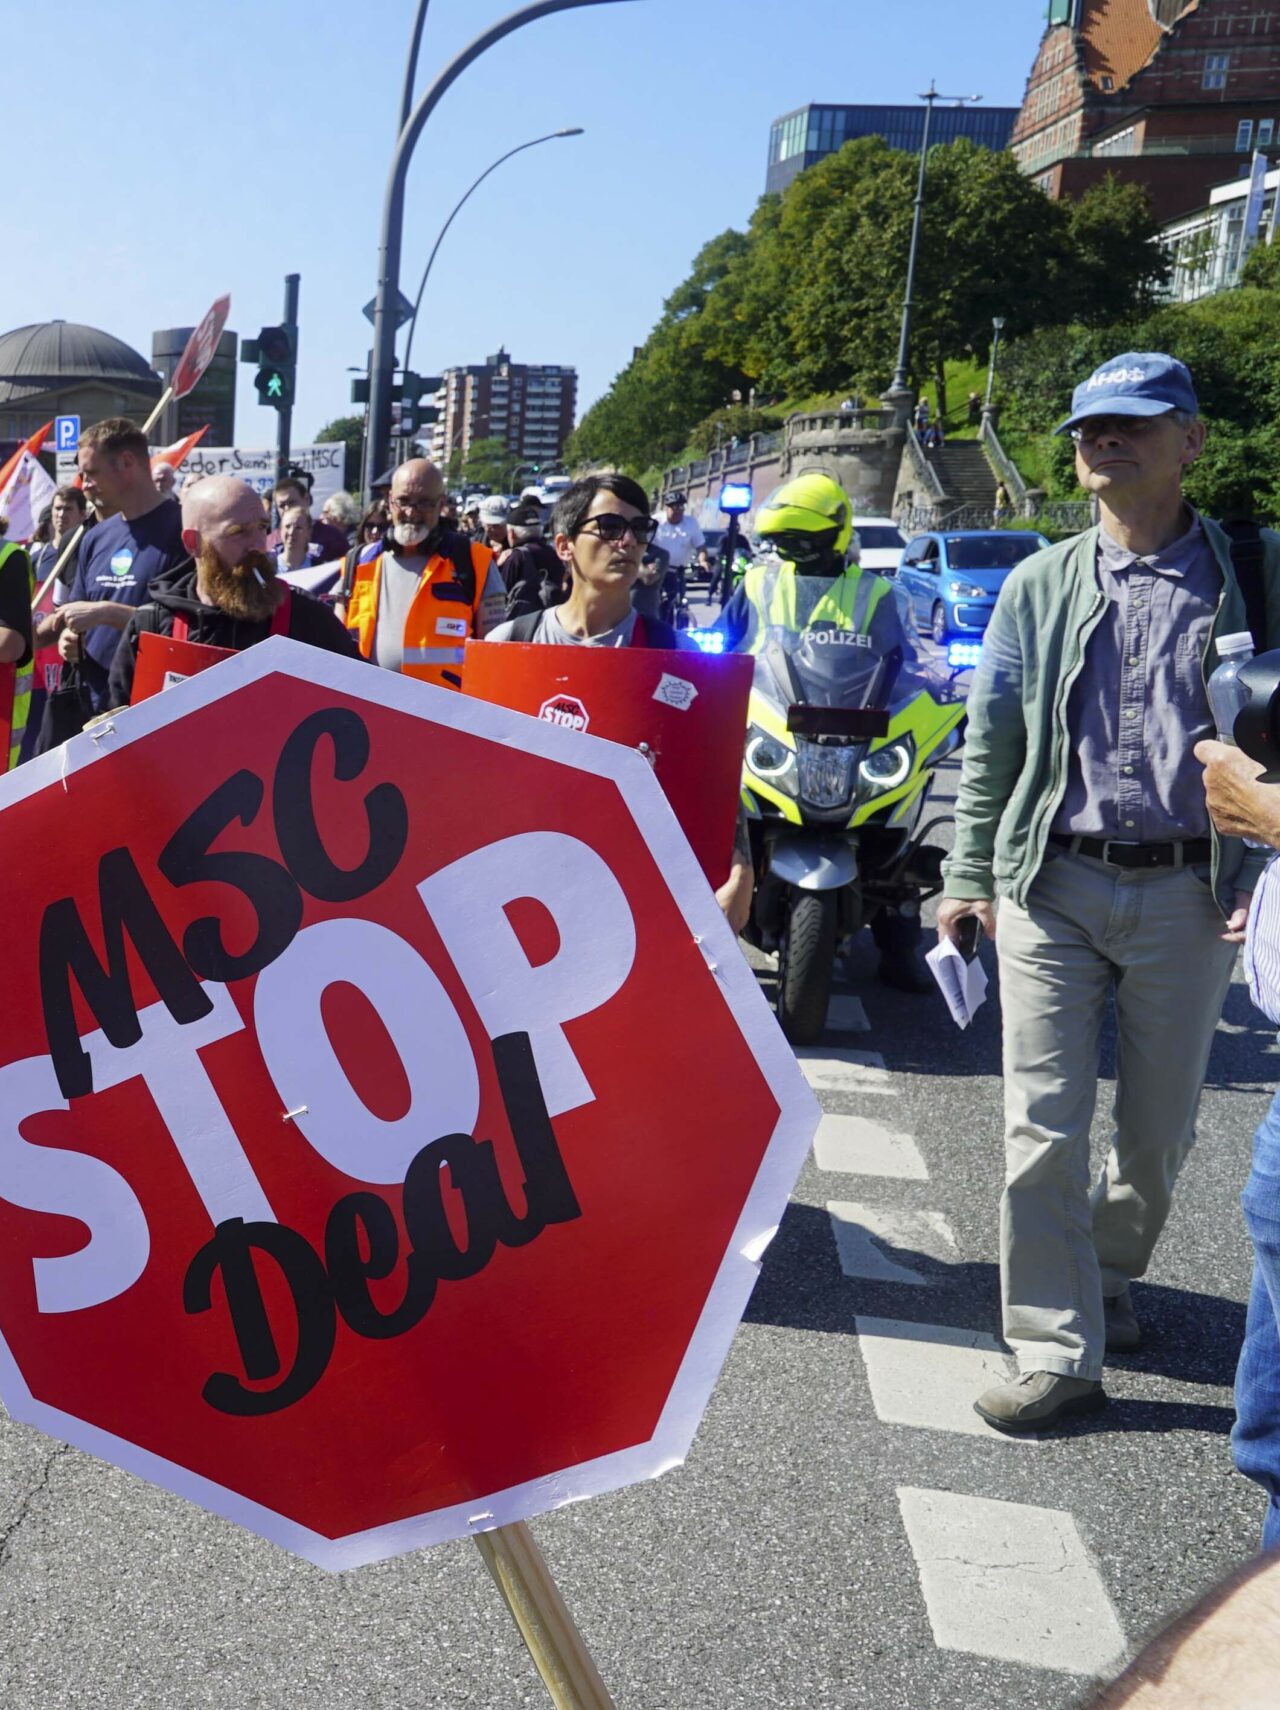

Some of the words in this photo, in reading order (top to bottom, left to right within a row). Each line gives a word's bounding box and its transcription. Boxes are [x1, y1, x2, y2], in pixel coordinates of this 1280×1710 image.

[60, 420, 74, 448] P
[177, 451, 230, 476] eder
[805, 629, 872, 649] POLIZEI
[542, 706, 585, 731] STOP
[39, 706, 409, 1100] MSC
[183, 1030, 582, 1417] Deal
